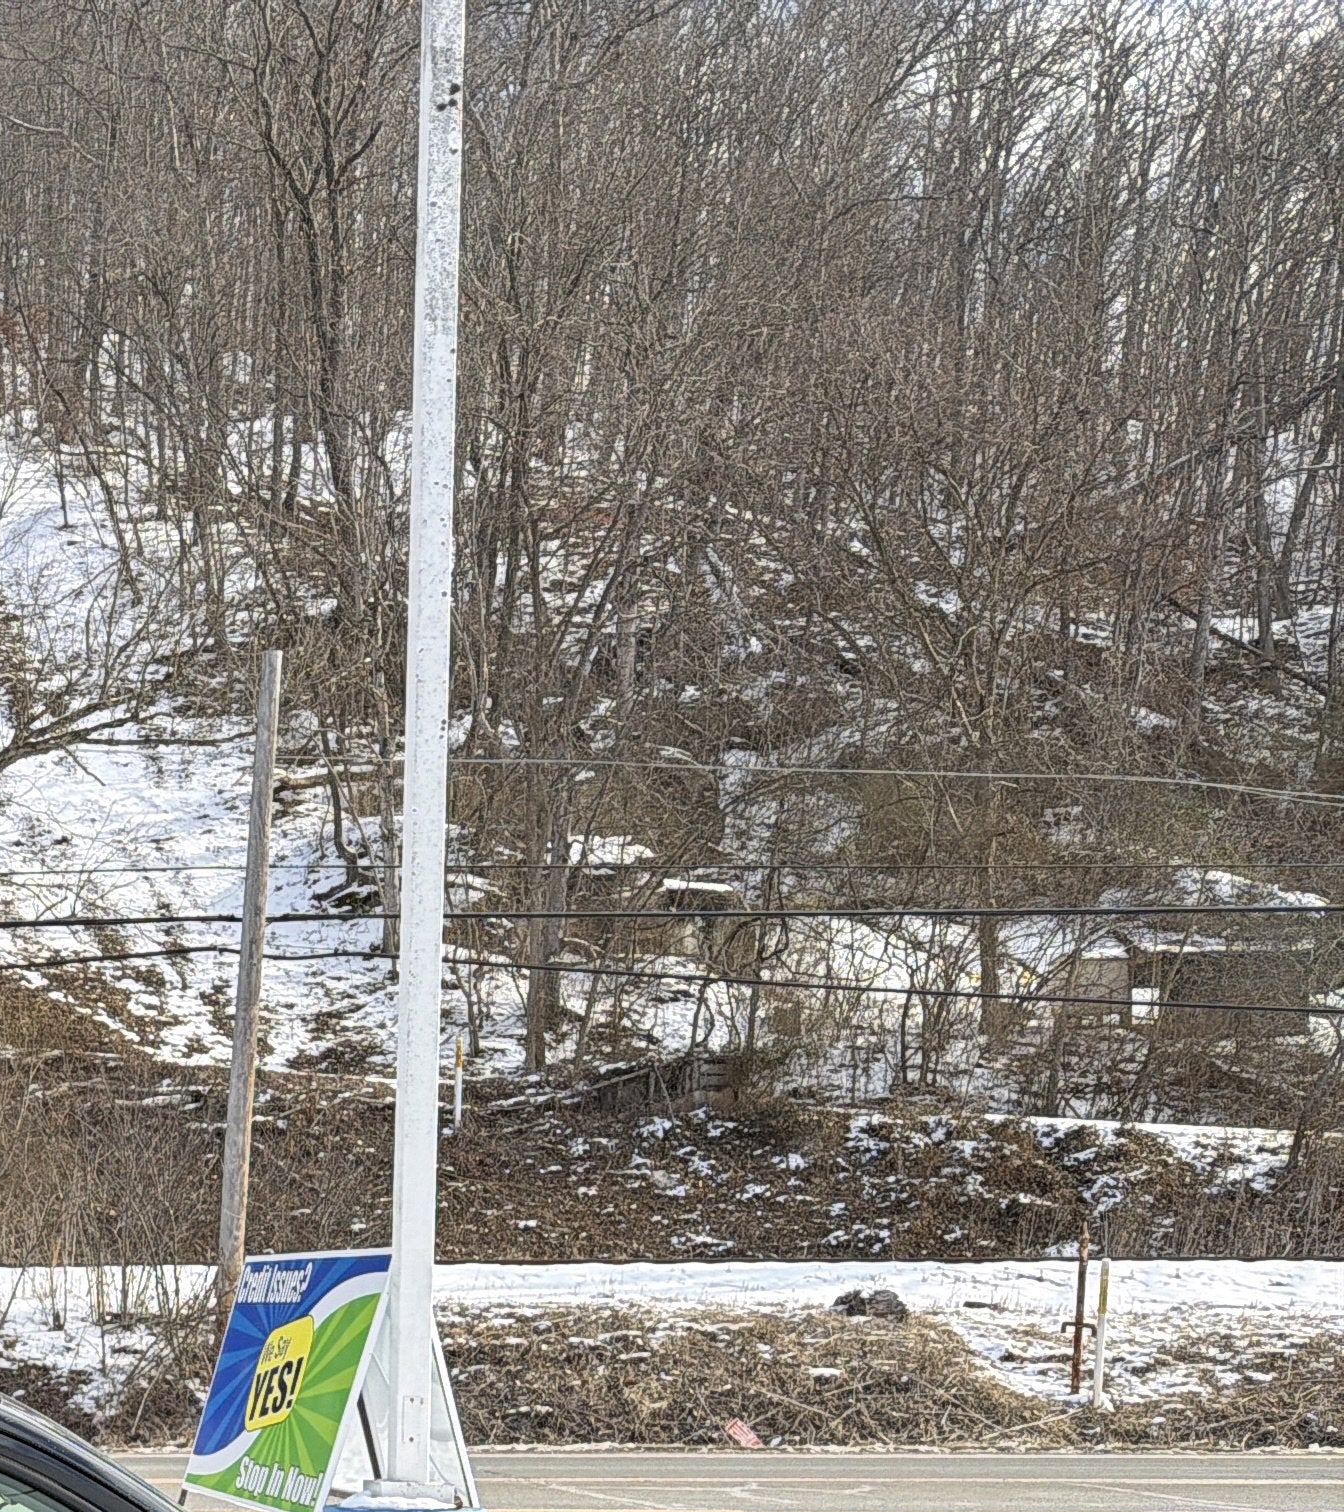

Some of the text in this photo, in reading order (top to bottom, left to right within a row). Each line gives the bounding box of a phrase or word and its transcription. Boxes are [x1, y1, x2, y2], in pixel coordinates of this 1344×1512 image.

[237, 1261, 313, 1304] Credit Issues?
[248, 1356, 305, 1421] YES!
[235, 1455, 324, 1507] Stop In Now!
